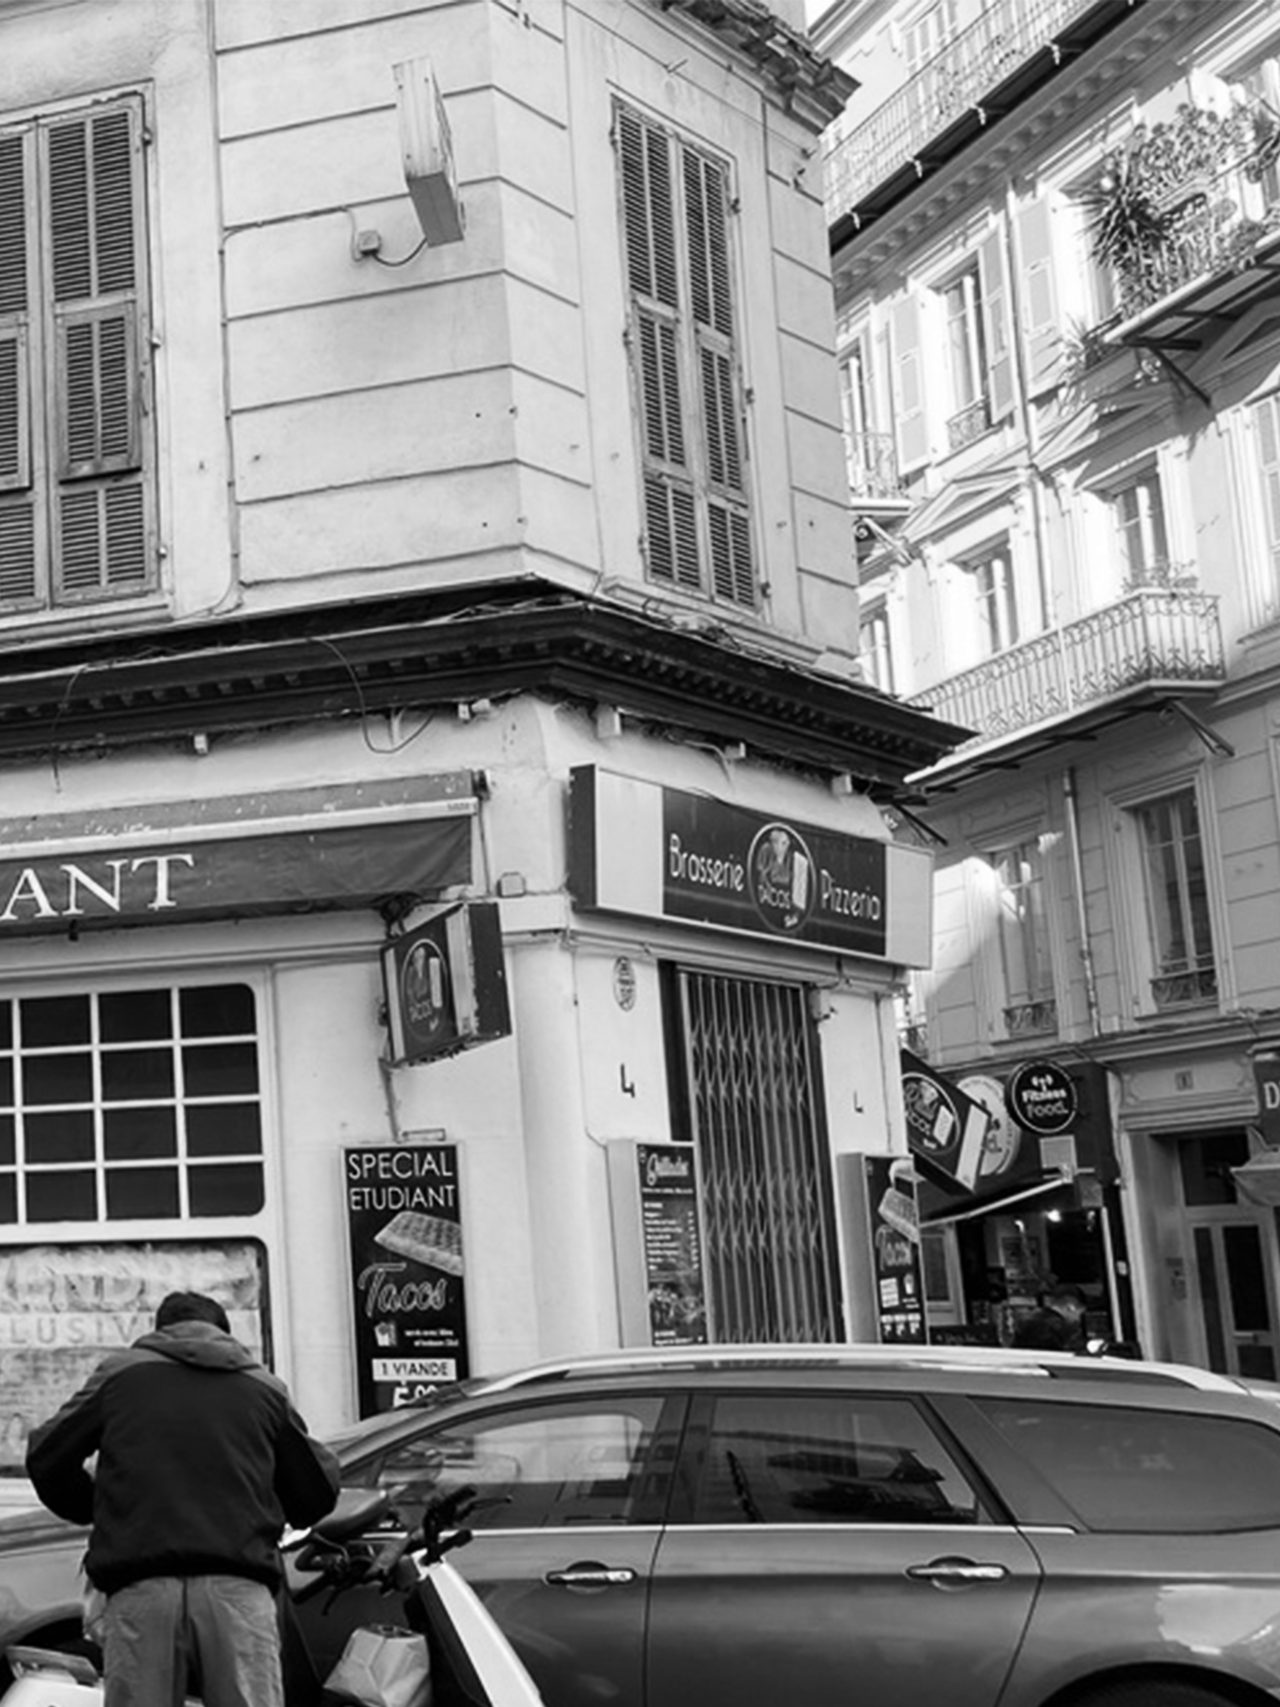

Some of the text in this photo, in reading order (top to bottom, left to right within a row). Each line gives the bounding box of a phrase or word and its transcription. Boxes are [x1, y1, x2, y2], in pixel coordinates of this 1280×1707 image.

[820, 868, 882, 921] Pizzeria
[348, 1151, 454, 1180] SPECIAL
[350, 1184, 456, 1211] ETUDIANT
[357, 1261, 449, 1318] Tacos
[392, 1361, 449, 1377] VIANDE
